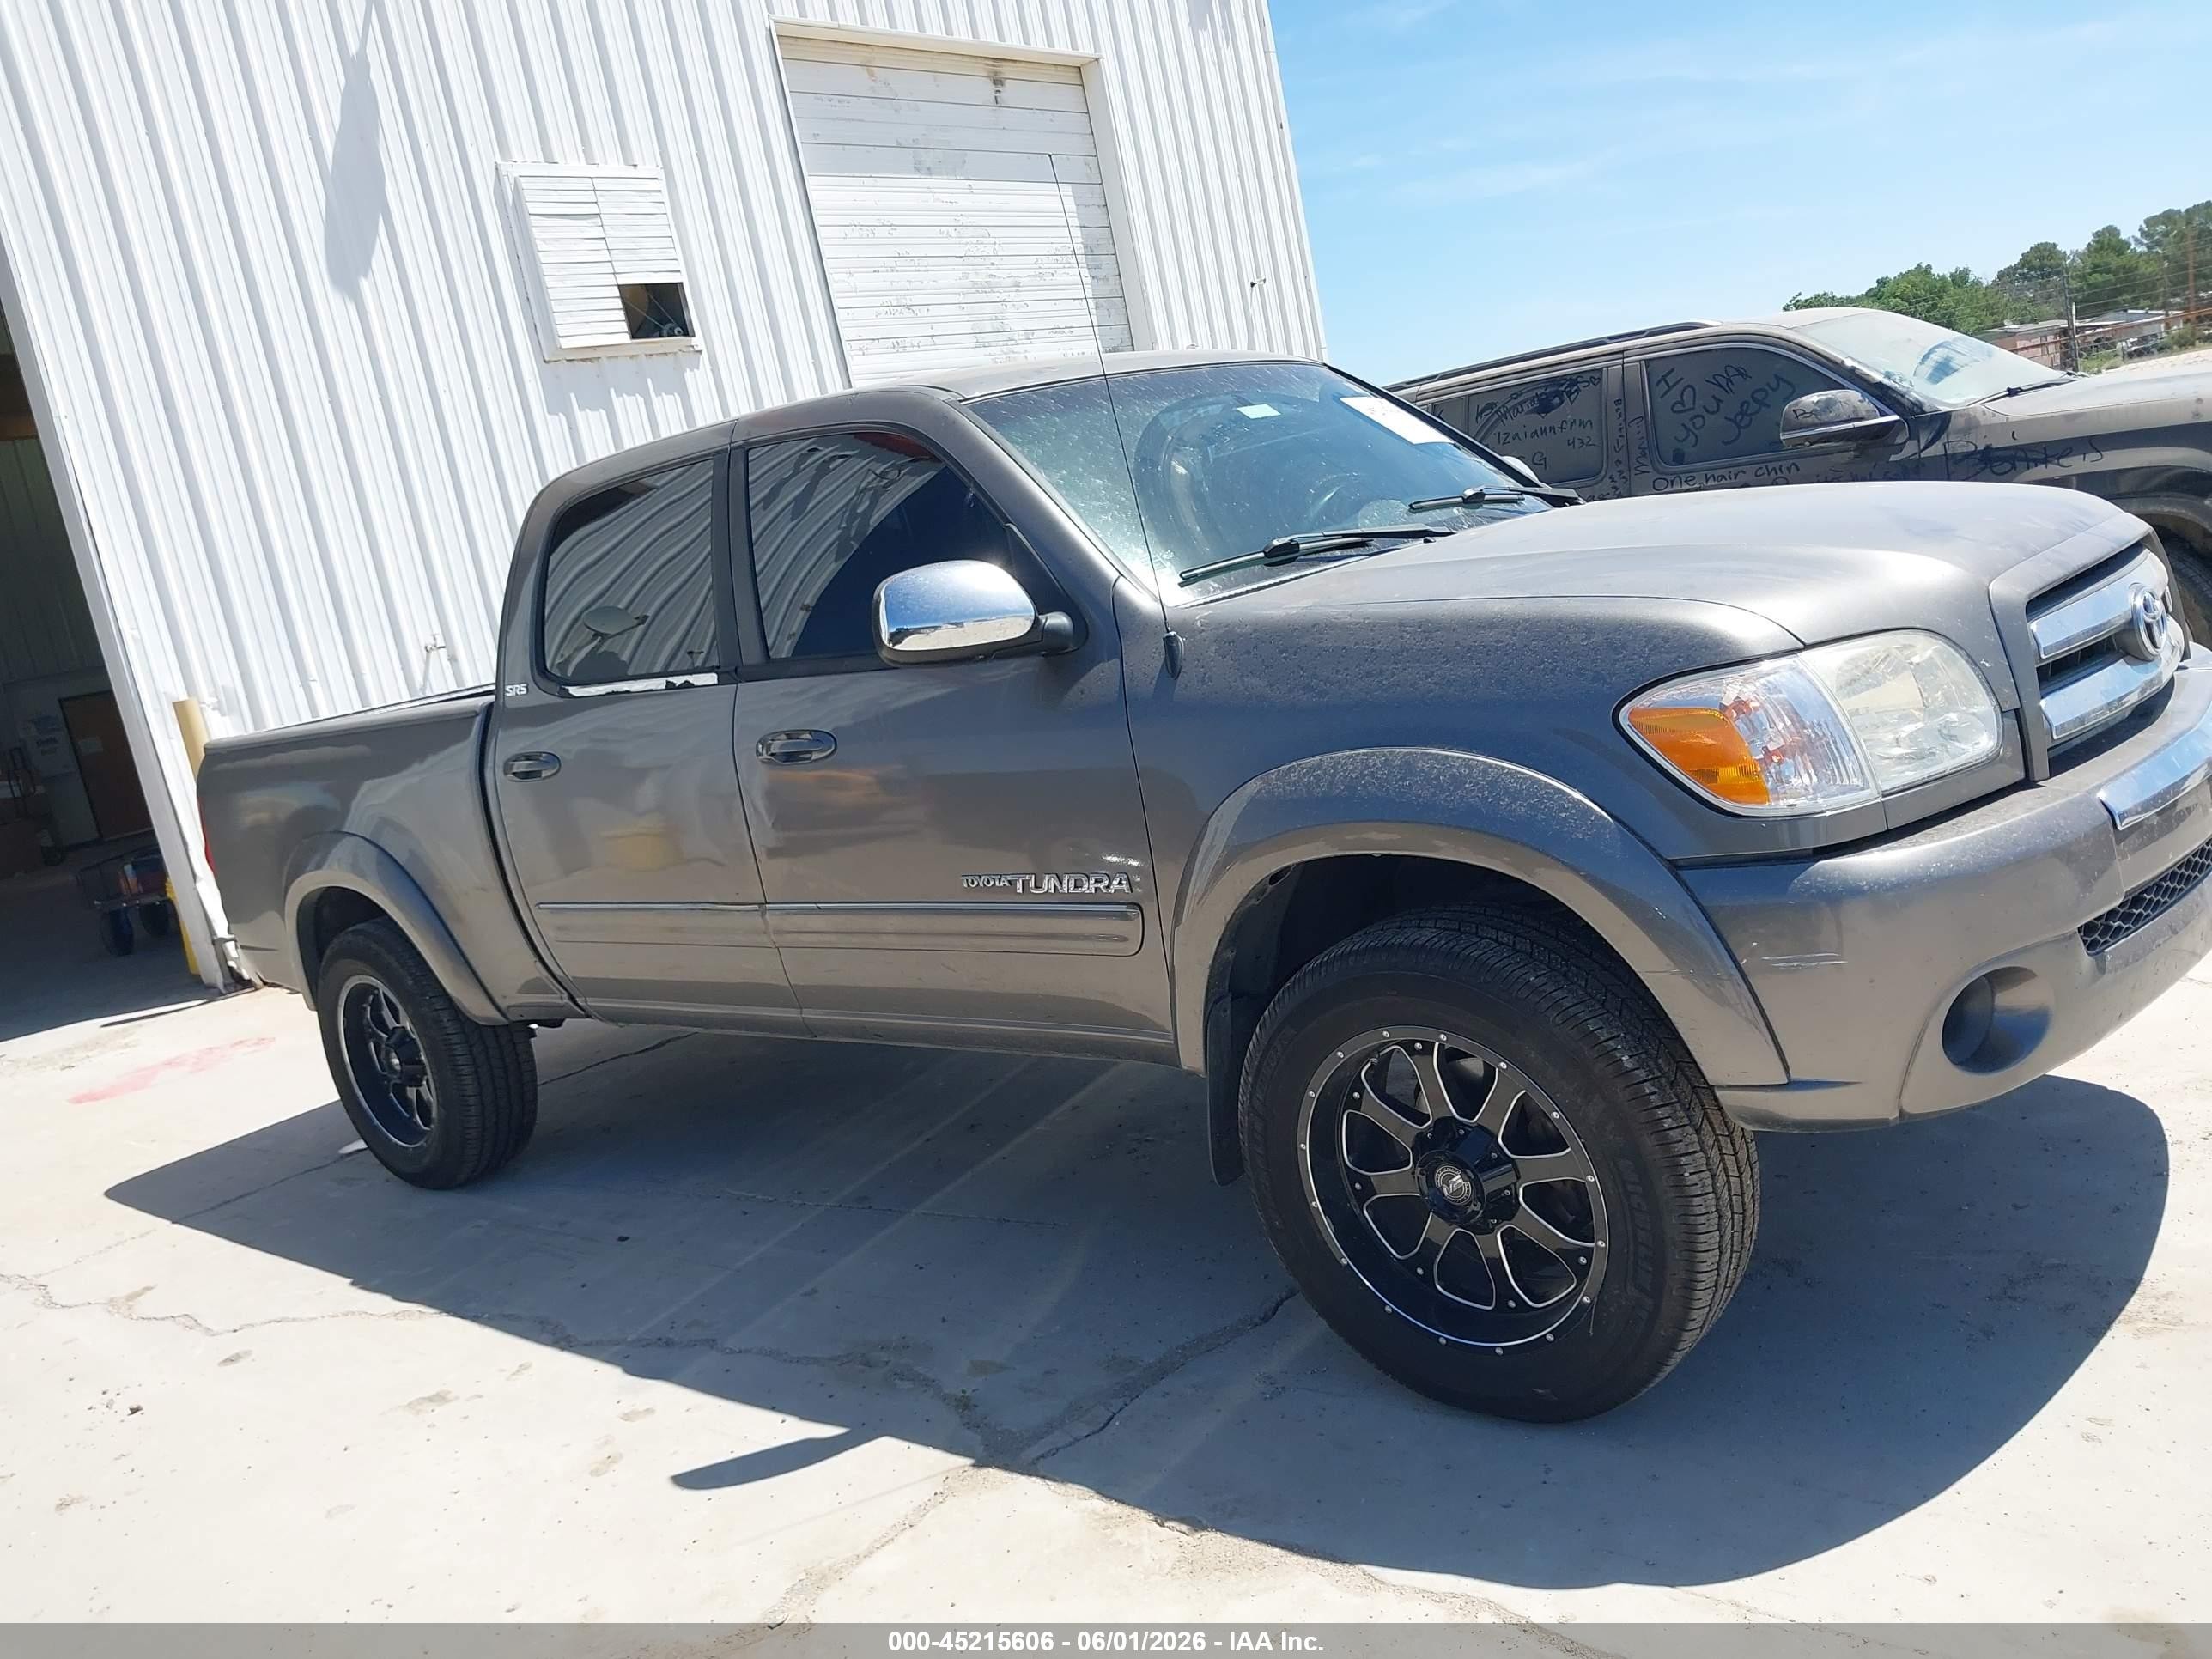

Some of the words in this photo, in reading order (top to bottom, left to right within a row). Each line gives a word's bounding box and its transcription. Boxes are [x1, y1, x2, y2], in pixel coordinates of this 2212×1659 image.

[1675, 395, 1723, 447] you
[1567, 438, 1596, 449] 432
[1705, 471, 1746, 485] hair
[1754, 462, 1801, 478] chin
[505, 684, 529, 696] SR5
[962, 874, 1011, 888] TOYOTA
[1007, 872, 1133, 894] TUNDRA
